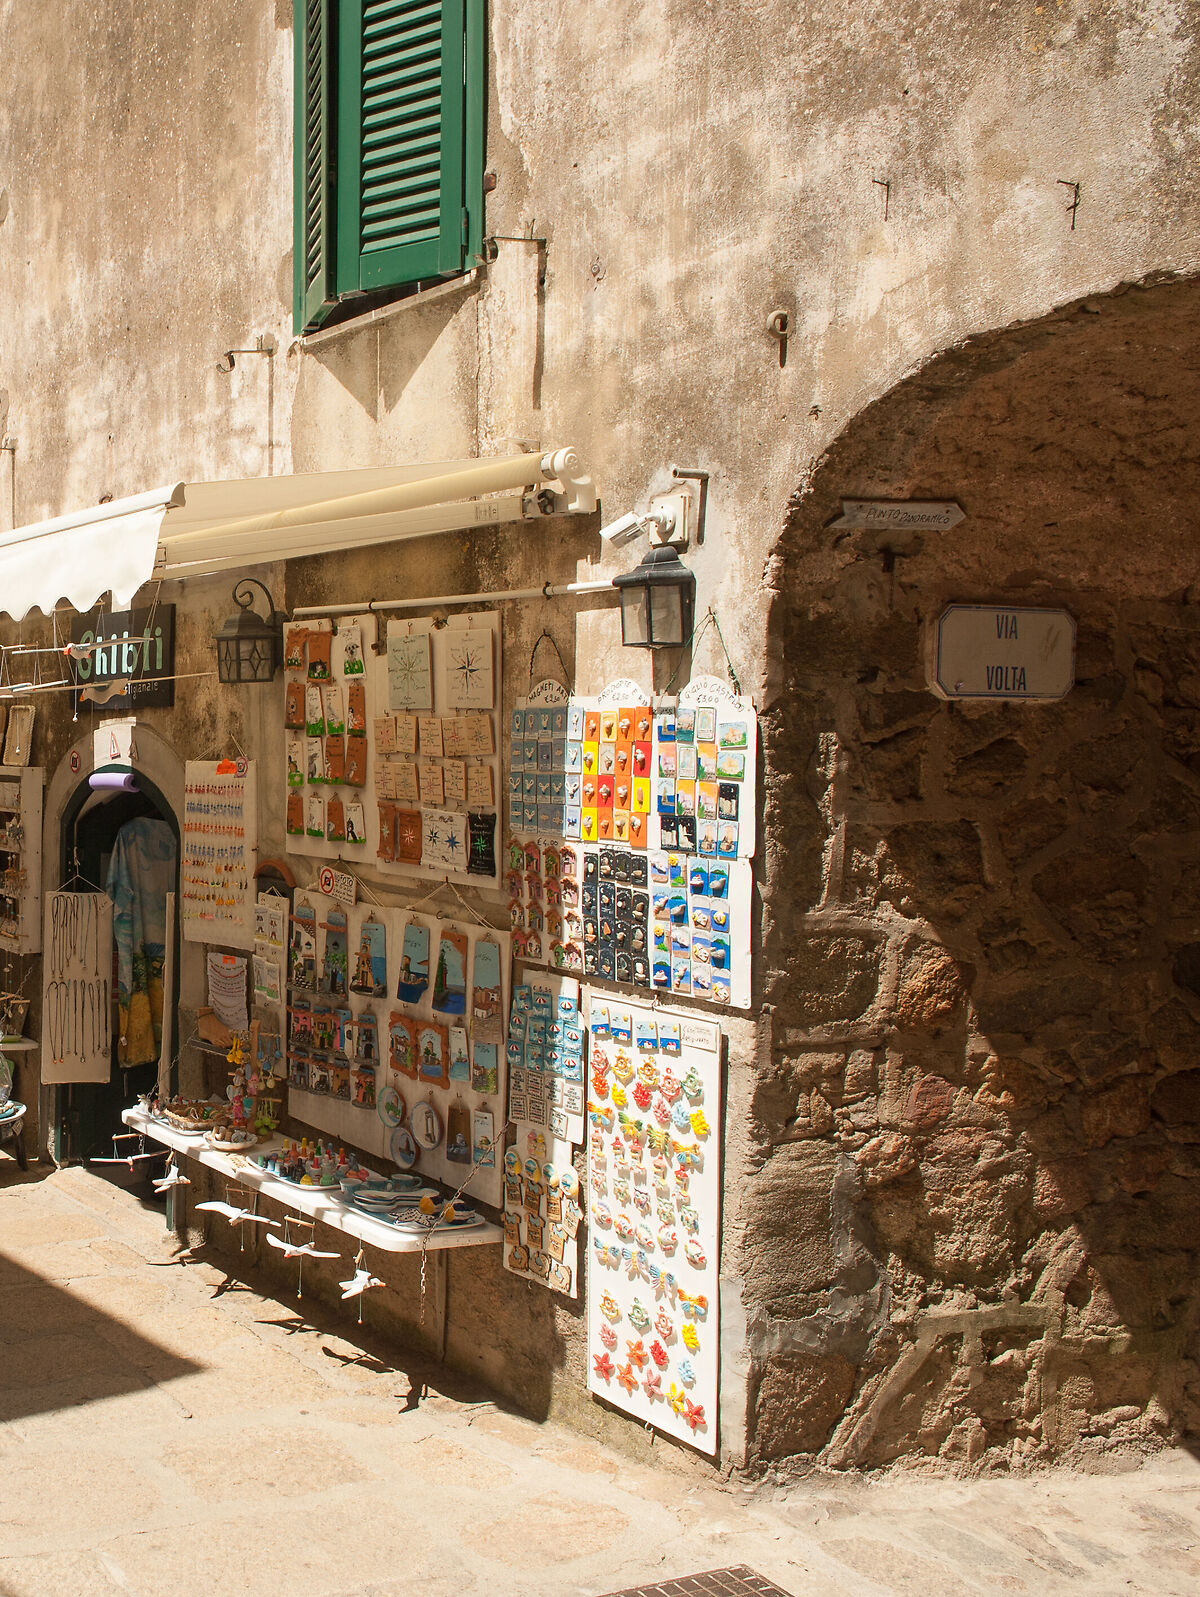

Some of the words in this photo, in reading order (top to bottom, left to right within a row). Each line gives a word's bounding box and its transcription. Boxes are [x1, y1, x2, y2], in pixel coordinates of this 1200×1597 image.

[865, 509, 901, 520] PUNTO
[900, 512, 950, 525] PANORAMICO
[996, 615, 1018, 640] VIA
[986, 665, 1027, 691] VOLTA
